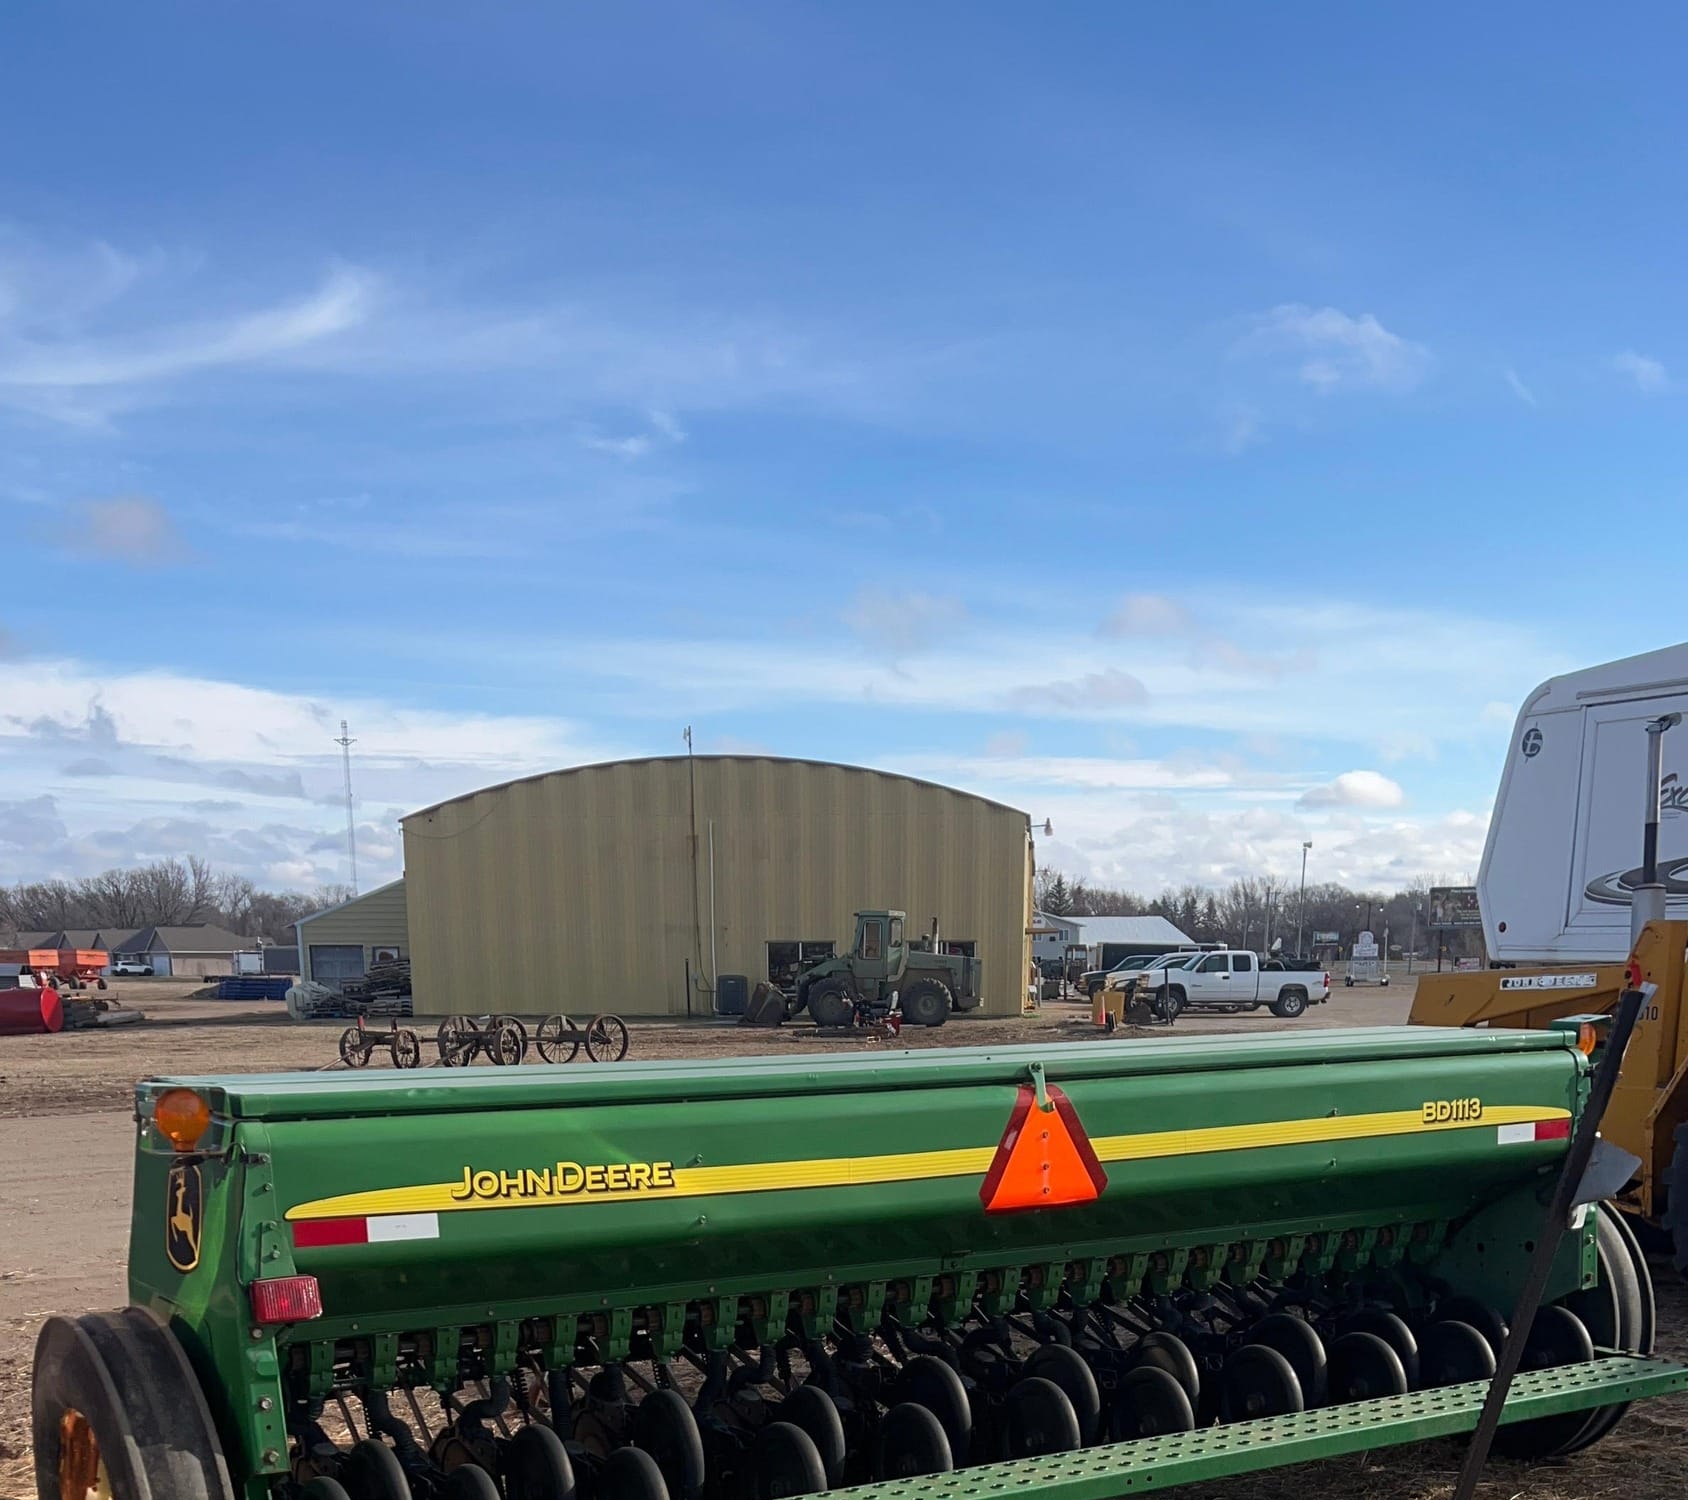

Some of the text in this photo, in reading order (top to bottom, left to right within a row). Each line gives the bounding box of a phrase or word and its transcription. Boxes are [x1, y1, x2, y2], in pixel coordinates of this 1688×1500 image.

[1423, 1098, 1482, 1123] BD1113
[451, 1161, 674, 1199] JOHN DEERE
